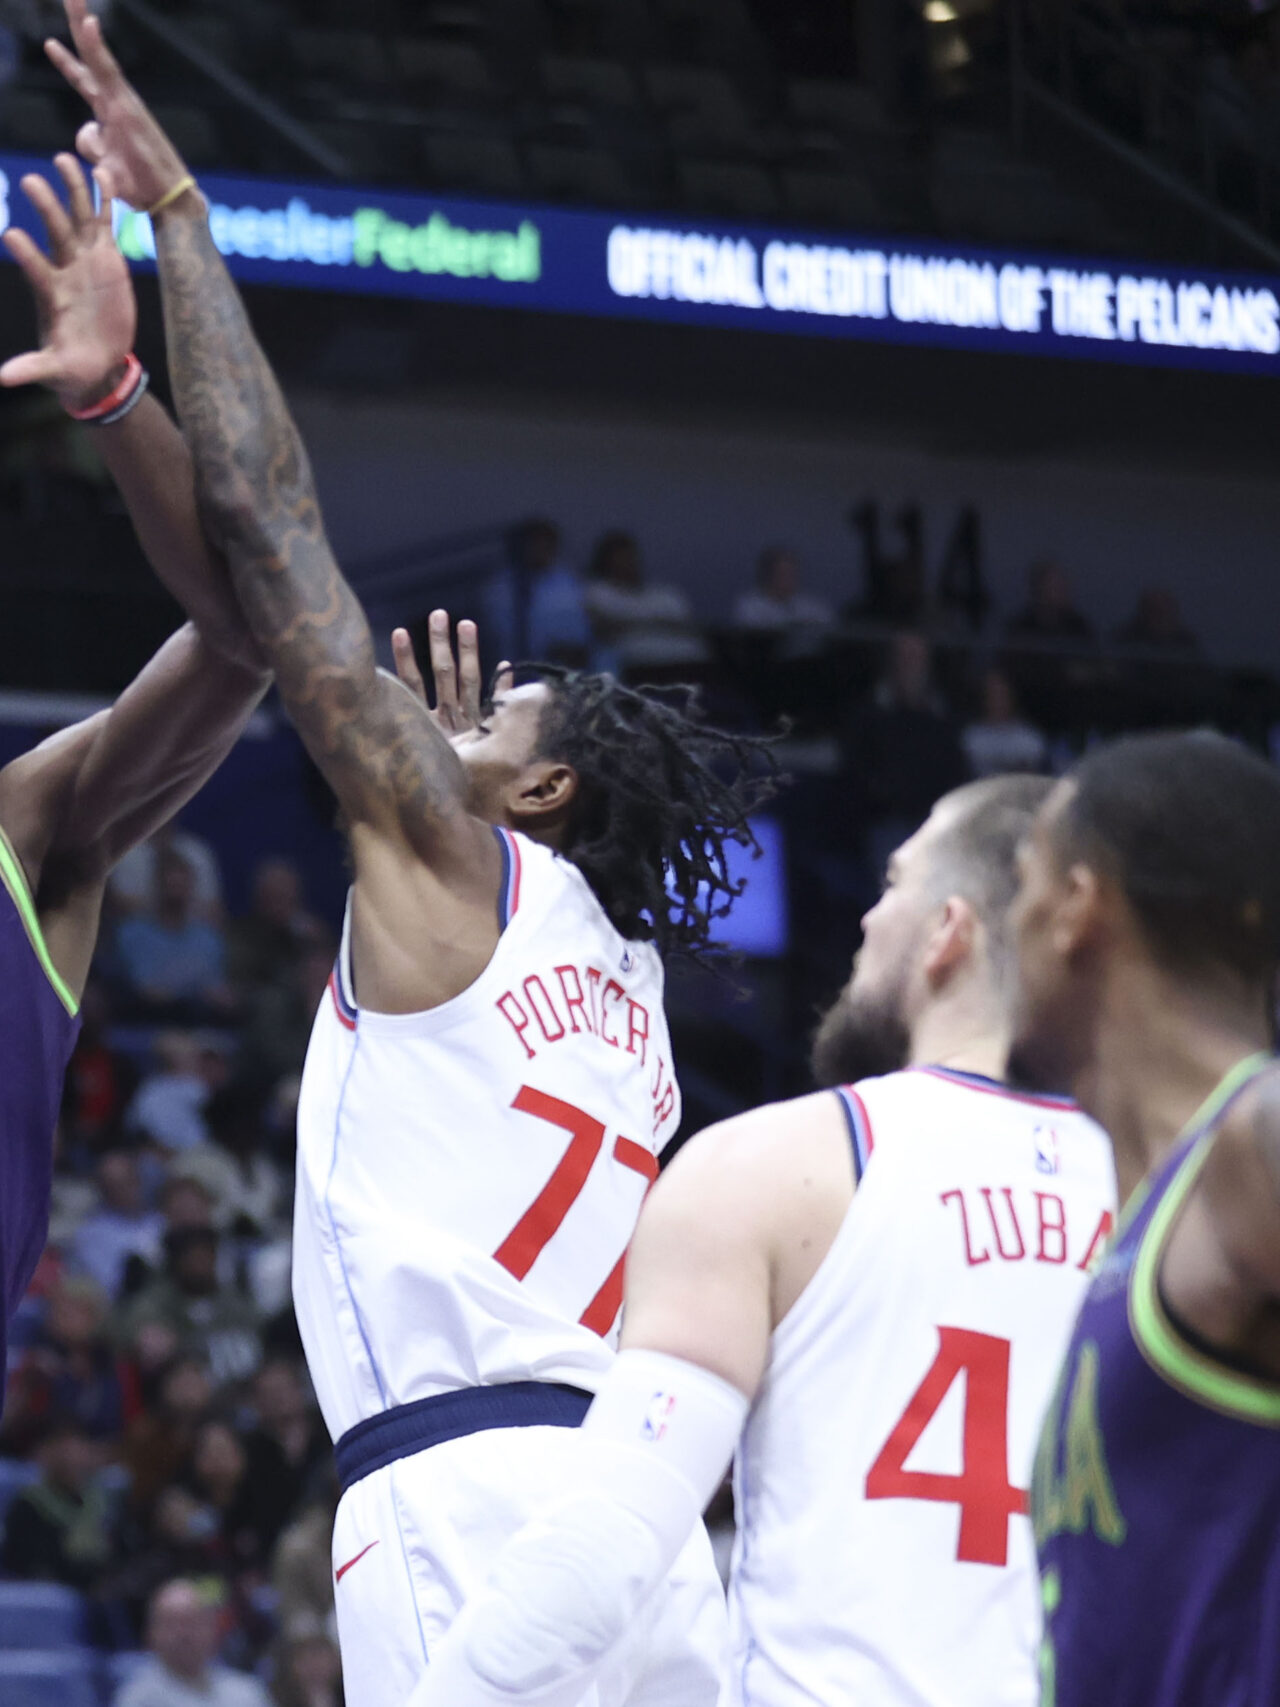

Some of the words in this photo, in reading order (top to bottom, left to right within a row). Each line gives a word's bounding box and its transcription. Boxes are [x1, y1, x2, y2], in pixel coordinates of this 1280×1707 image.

[208, 197, 541, 283] eeslerFederal
[607, 225, 765, 309] OFFICIAL
[762, 240, 888, 320] CREDIT
[888, 252, 1001, 329] UNION
[998, 262, 1050, 333] OF
[1045, 267, 1118, 340] THE
[1115, 274, 1280, 354] PELICANS
[495, 964, 649, 1067] PORTER
[493, 1084, 660, 1338] 77
[864, 1325, 1030, 1567] 4
